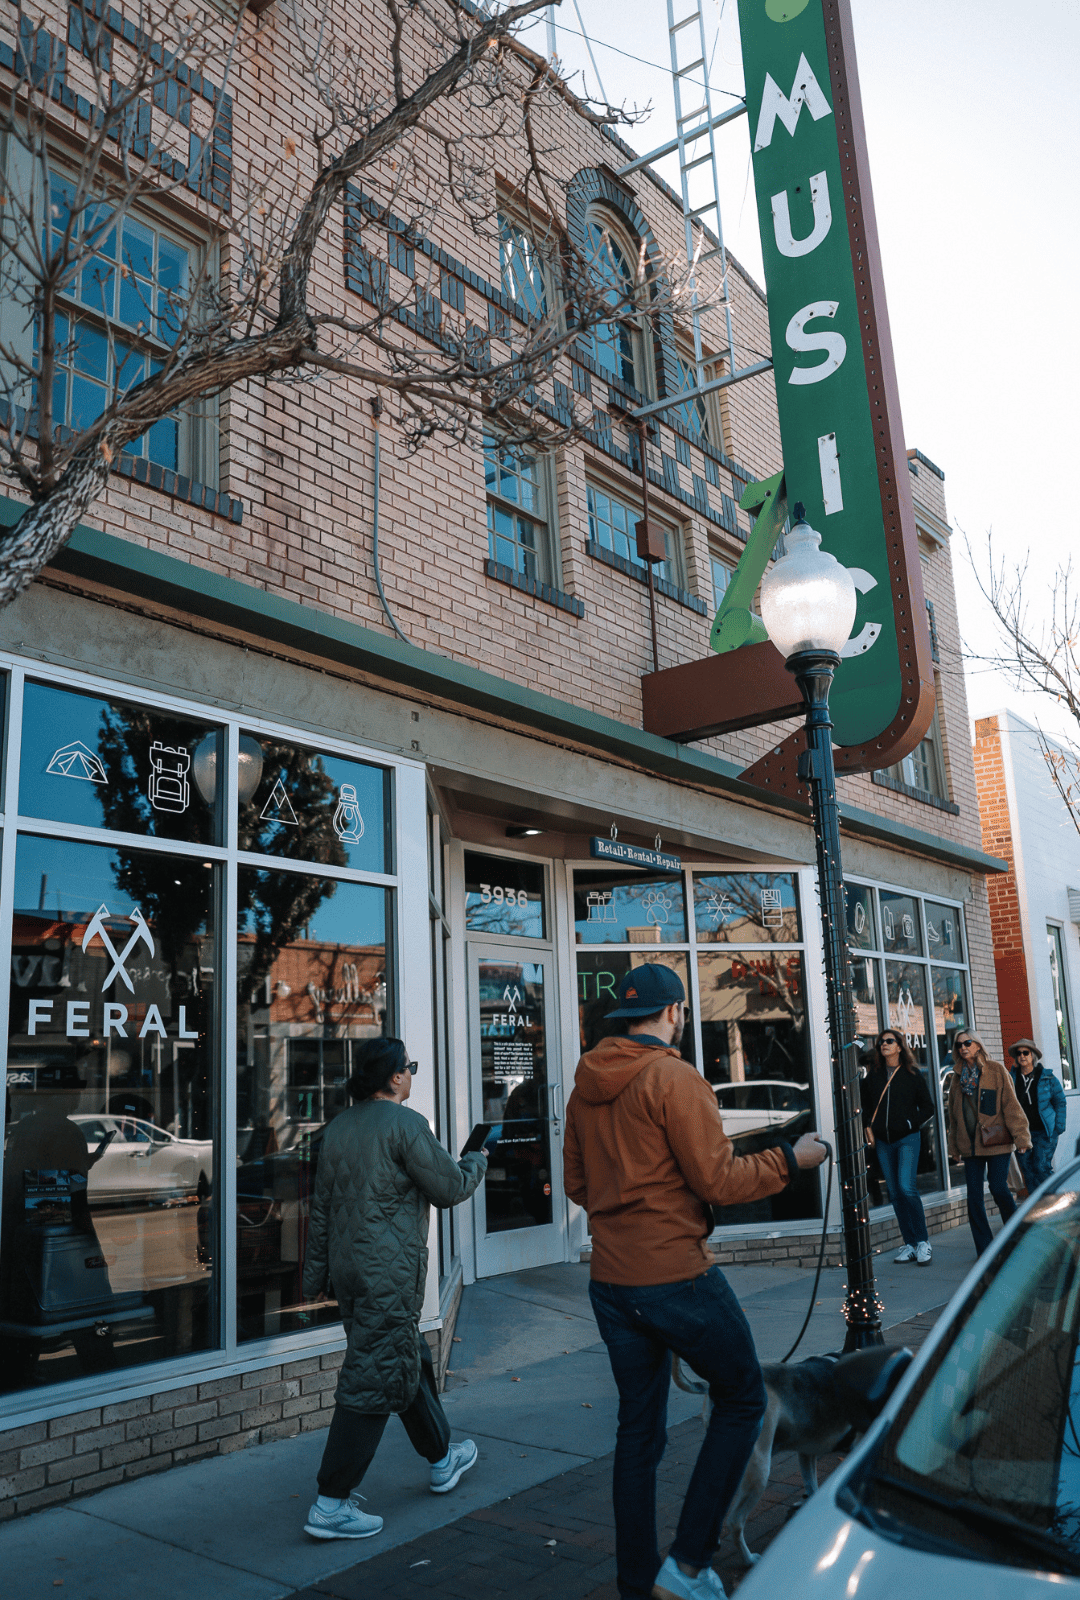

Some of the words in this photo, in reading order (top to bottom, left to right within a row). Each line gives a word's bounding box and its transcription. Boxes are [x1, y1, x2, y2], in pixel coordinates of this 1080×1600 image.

[597, 840, 624, 857] Retail
[627, 847, 653, 864] Rental
[656, 854, 681, 870] Repair
[480, 883, 528, 909] 3936
[27, 998, 199, 1039] FERAL
[492, 1013, 533, 1028] FERAL
[901, 1032, 928, 1049] RAL
